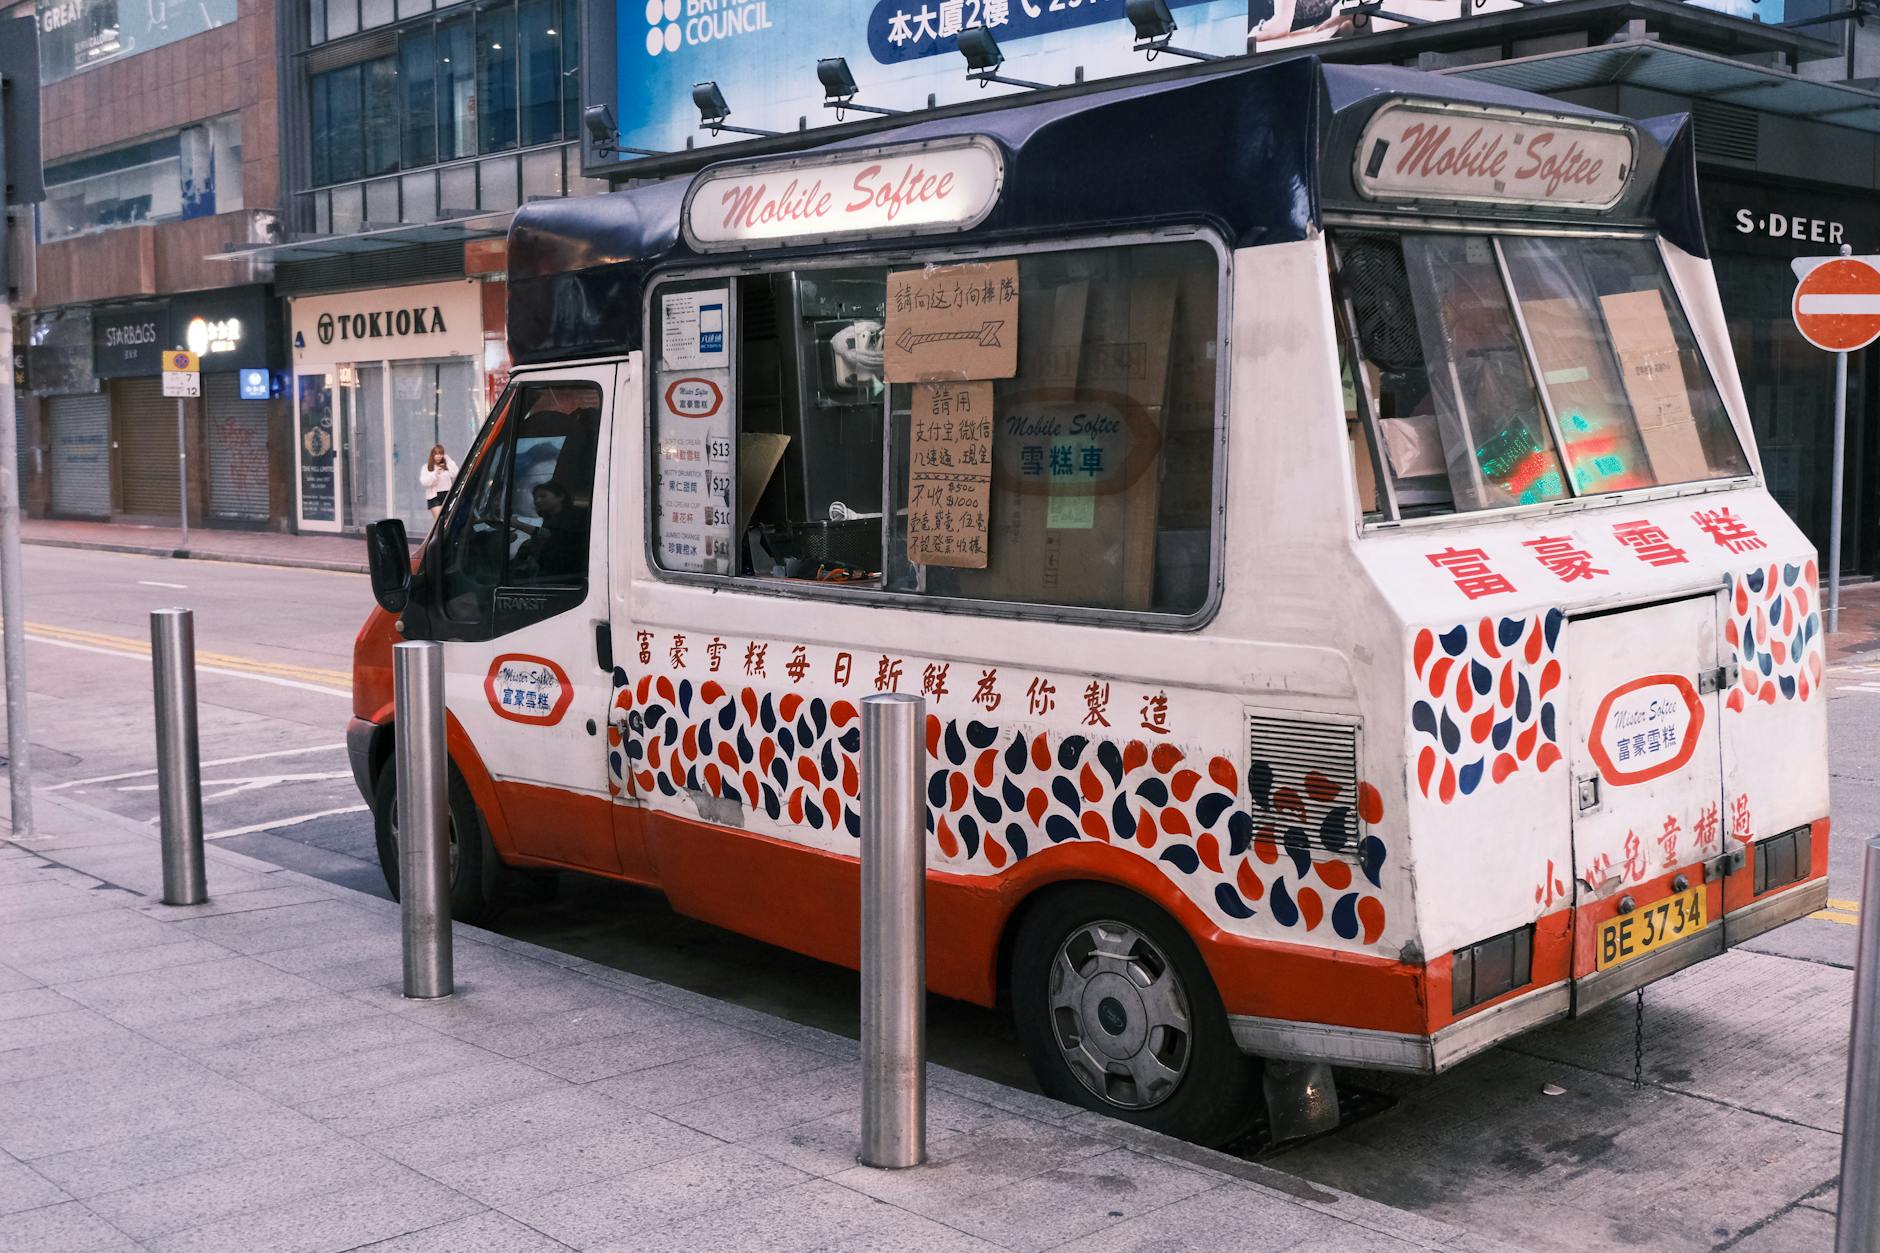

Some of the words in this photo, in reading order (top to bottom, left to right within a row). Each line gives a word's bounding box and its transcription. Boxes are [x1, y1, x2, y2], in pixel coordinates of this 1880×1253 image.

[686, 1, 773, 45] COUNCIL
[888, 0, 1009, 46] 本大廈2樓
[1396, 122, 1508, 177] Mobile
[1514, 131, 1603, 197] Softee
[721, 179, 832, 229] Mobile
[845, 164, 955, 221] Softee
[338, 307, 447, 339] TOKIOKA
[187, 387, 198, 395] 12
[932, 385, 970, 416] 請用
[1007, 416, 1061, 436] Mobile
[1070, 414, 1120, 440] Softee
[712, 441, 730, 458] $13
[1021, 445, 1104, 477] 雪糕車
[912, 484, 943, 508] 不收
[1425, 506, 1768, 600] 富豪雪糕
[502, 687, 550, 709] 富豪雪糕
[1614, 710, 1645, 729] Mister
[1649, 698, 1677, 723] Softee
[1617, 724, 1676, 761] 富豪雪糕
[1603, 918, 1633, 963] BE
[1642, 892, 1700, 946] 3734
